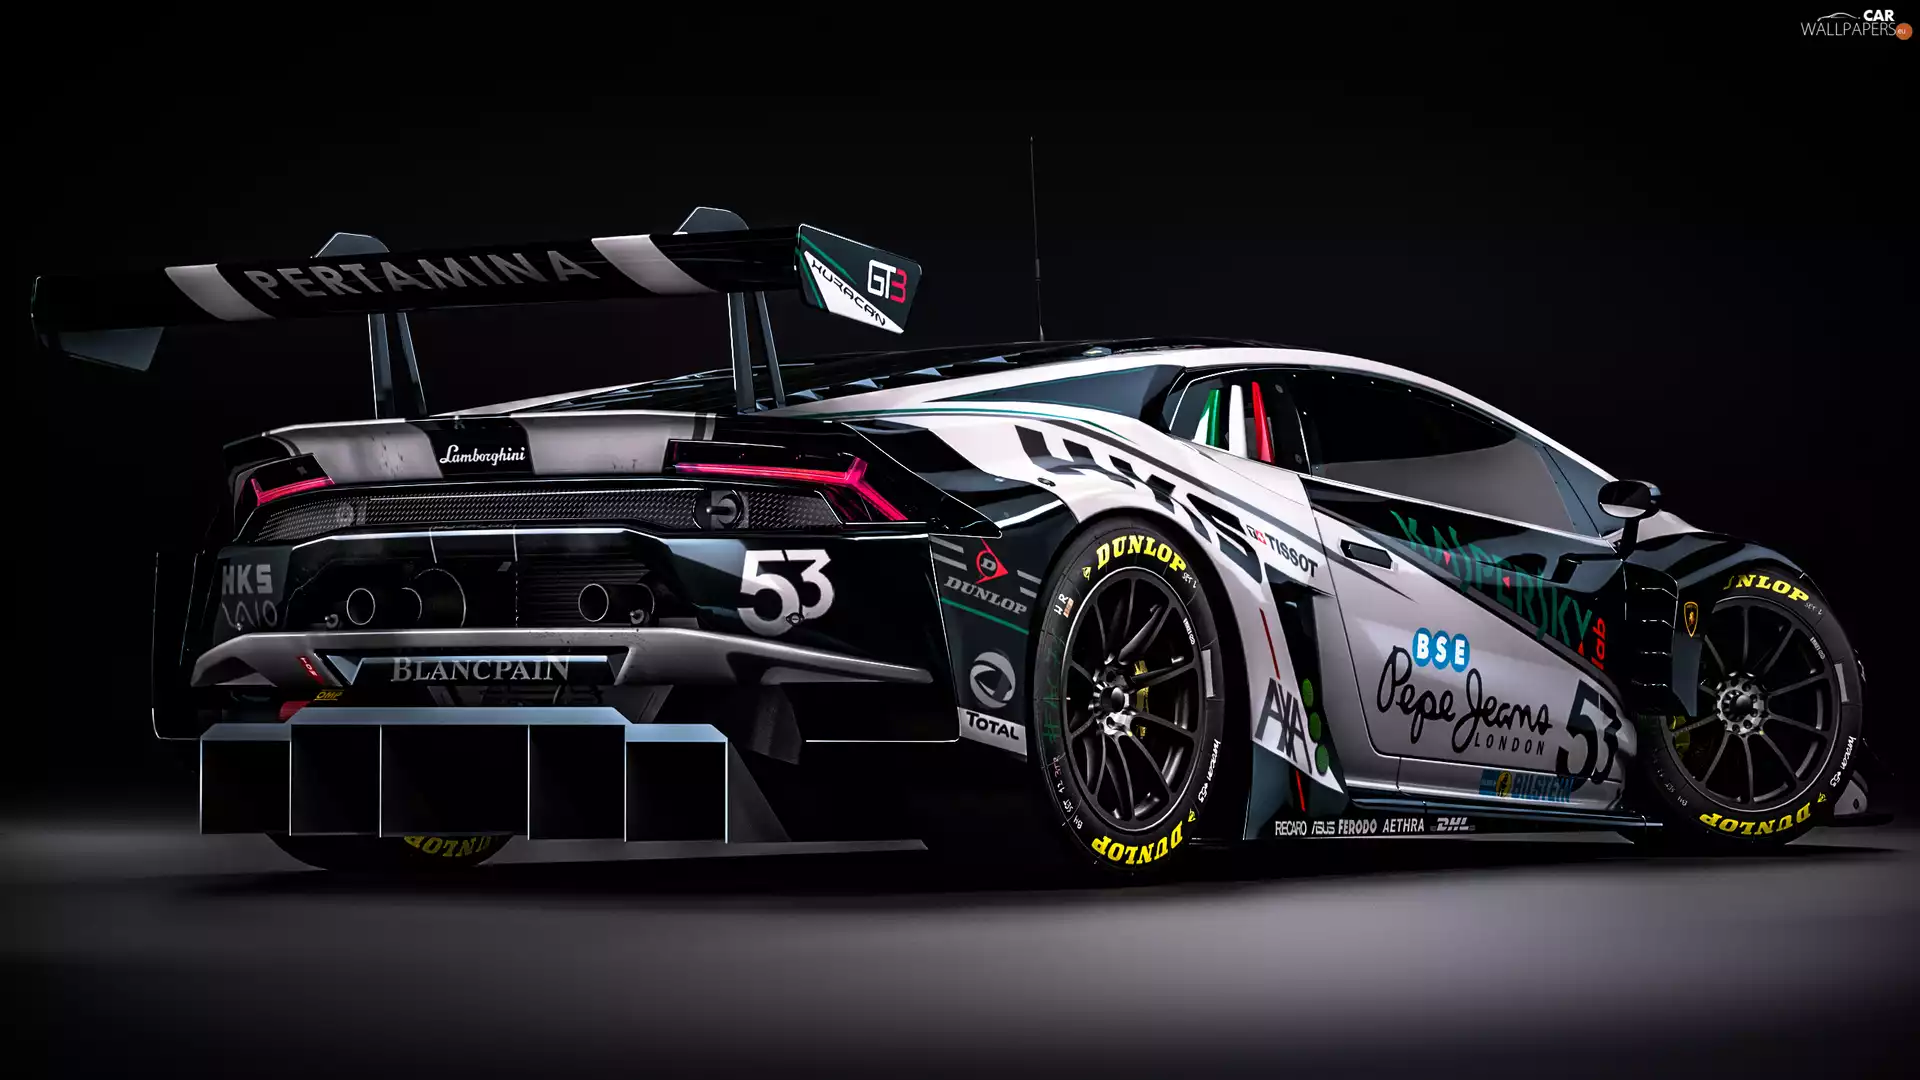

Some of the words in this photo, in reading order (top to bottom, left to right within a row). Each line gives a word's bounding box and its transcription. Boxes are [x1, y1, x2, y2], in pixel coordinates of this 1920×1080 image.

[244, 249, 601, 300] PERTAMINA
[811, 259, 886, 326] HURACAN
[867, 259, 908, 304] GT3
[440, 444, 526, 466] Lamborghini
[1095, 534, 1188, 572] DUNLOP
[1264, 532, 1319, 578] TISSOT
[222, 564, 273, 595] HKS
[736, 548, 836, 637] 53
[944, 576, 1028, 616] DUNLOP
[1722, 574, 1810, 602] NLOP
[1415, 631, 1467, 667] BSE
[390, 656, 570, 683] BLANCPAIN
[1377, 645, 1456, 744] Pepe
[1452, 668, 1552, 753] Jeans
[966, 710, 1020, 741] TOTAL
[1254, 677, 1313, 775] AXA
[1474, 732, 1546, 756] LONDON
[1554, 679, 1622, 793] 53
[1275, 820, 1308, 837] RECARO
[1311, 820, 1336, 836] ASUS
[1338, 818, 1378, 836] FERODO
[1382, 817, 1426, 834] AETHRA
[1436, 816, 1470, 833] DHL
[1699, 801, 1812, 836] DUNLOP
[1091, 820, 1183, 865] DUNLOP
